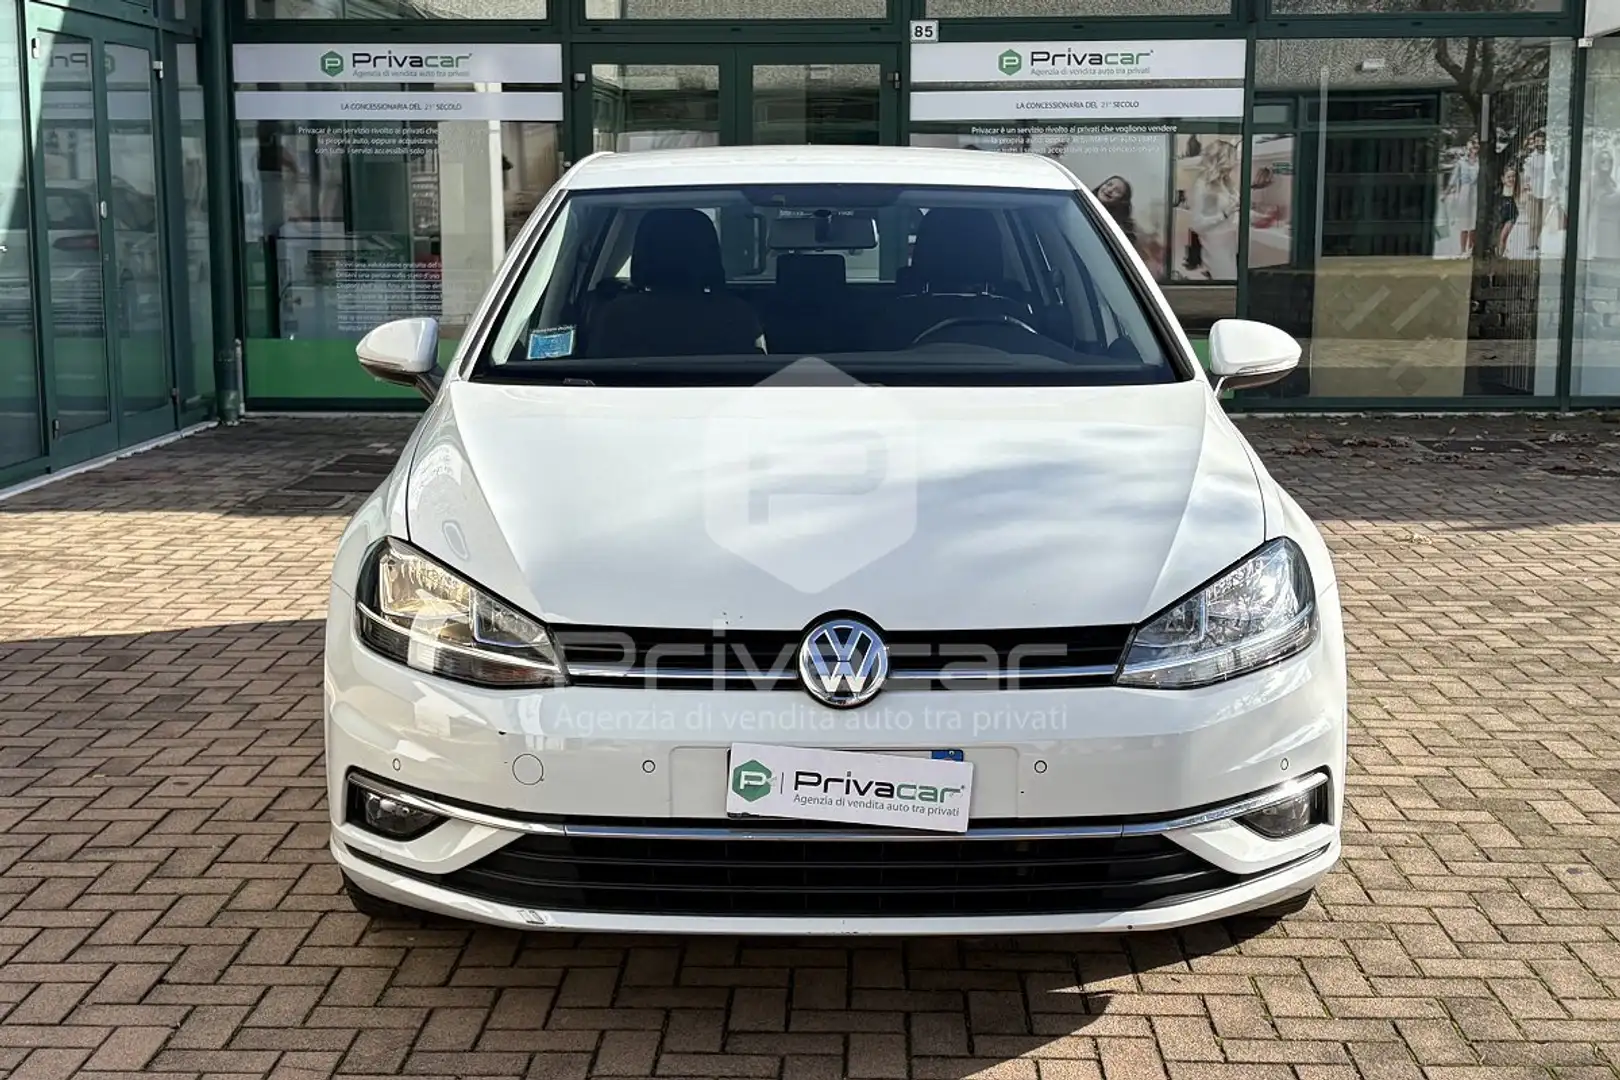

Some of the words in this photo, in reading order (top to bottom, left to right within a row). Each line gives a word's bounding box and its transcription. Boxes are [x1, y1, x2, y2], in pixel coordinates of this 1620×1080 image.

[913, 25, 934, 38] 85
[352, 50, 470, 69] Privacar
[1030, 48, 1151, 66] Privacar
[352, 69, 380, 79] Agenzia
[382, 69, 390, 77] di
[392, 69, 417, 77] vendita
[448, 69, 470, 78] privati
[1031, 67, 1060, 77] Agenzia
[1061, 67, 1069, 75] di
[1070, 67, 1096, 75] vendita
[1097, 67, 1115, 76] auto
[1116, 67, 1126, 75] tra
[1127, 66, 1150, 76] privati
[340, 103, 350, 111] LA
[350, 103, 408, 111] CONCESSIONARIA
[409, 103, 421, 111] DEL
[436, 103, 462, 111] SECOLO
[1016, 102, 1025, 110] LA
[1026, 101, 1084, 110] CONCESSIONARIA
[1085, 101, 1098, 109] DEL
[1112, 101, 1139, 109] SECOLO
[298, 127, 325, 135] Privacar
[402, 127, 425, 136] privati
[971, 126, 999, 135] Privacar
[1017, 126, 1044, 134] servizio
[1045, 125, 1068, 134] rivolto
[1069, 125, 1076, 134] ai
[1077, 125, 1100, 134] privati
[1101, 124, 1115, 133] che
[1115, 125, 1147, 134] vogliono
[1148, 124, 1178, 133] vendere
[793, 771, 961, 803] Privacar
[793, 793, 833, 807] Agenzia
[834, 796, 846, 807] di
[847, 798, 884, 810] vendita
[886, 801, 910, 812] auto
[911, 804, 925, 814] tra
[927, 806, 960, 818] privati
